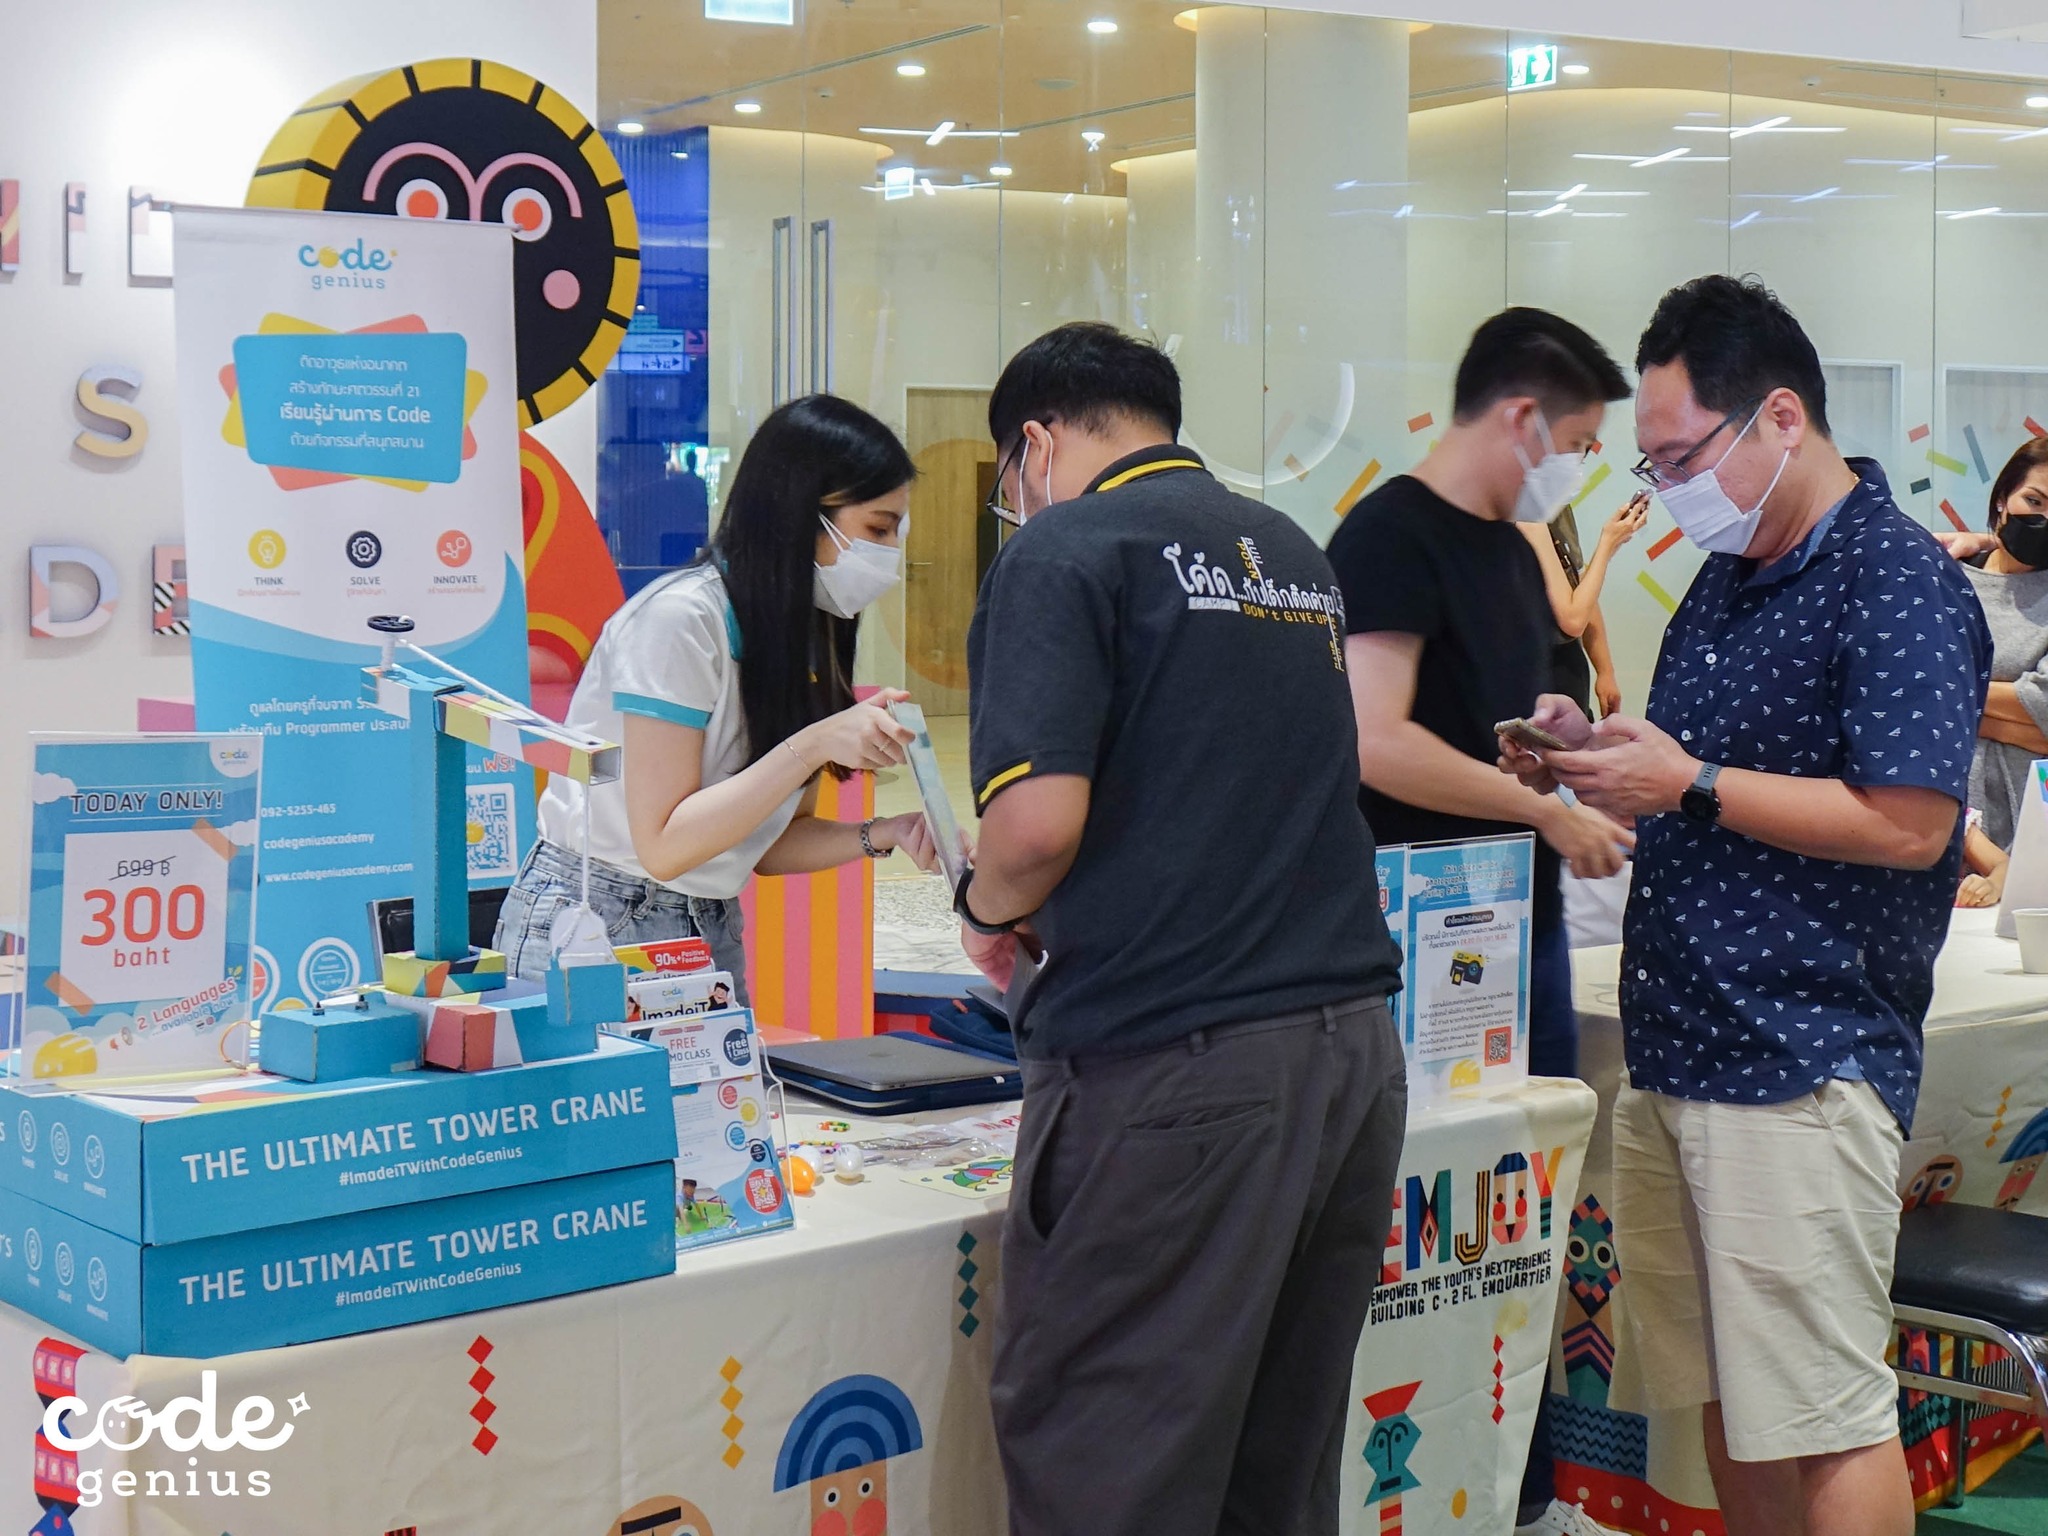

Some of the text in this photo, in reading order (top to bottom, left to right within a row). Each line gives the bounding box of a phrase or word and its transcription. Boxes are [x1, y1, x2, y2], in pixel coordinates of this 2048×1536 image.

[298, 238, 395, 271] code
[311, 272, 386, 290] genius
[407, 386, 420, 397] 21
[280, 401, 431, 427] เรียนรู้ผ่านการ Code
[1236, 542, 1259, 579] POSN
[254, 577, 284, 586] THINK
[350, 576, 381, 586] SOLVE
[433, 574, 478, 585] INNOVATE
[1284, 611, 1315, 624] GIVE
[1316, 614, 1328, 625] UP
[286, 720, 366, 736] Programmer
[70, 790, 223, 814] TODAY ONLY!
[261, 803, 337, 818] 092-5255-465
[263, 832, 375, 850] codegeniusacademy
[117, 859, 154, 877] 699
[265, 862, 414, 882] www.codegeniusacademy.com
[80, 884, 206, 946] 300
[114, 947, 171, 968] baht
[681, 949, 705, 957] Positive
[681, 955, 710, 964] Feedback
[137, 977, 236, 1030] 2 Languages
[670, 1036, 697, 1049] FREE
[725, 1038, 748, 1050] Free
[669, 1049, 711, 1061] MO CLASS
[180, 1147, 250, 1183] THE
[263, 1122, 415, 1171] ULTIMATE
[427, 1104, 539, 1145] TOWER
[551, 1087, 646, 1126] CRANE
[339, 1146, 522, 1186] #ImadeiTWithCodeGenius
[179, 1268, 246, 1305] THE
[262, 1240, 415, 1292] ULTIMATE
[428, 1219, 540, 1263] TOWER
[552, 1199, 647, 1241] CRANE
[335, 1263, 522, 1307] #ImadeiTWithCodeGenius
[1371, 1249, 1552, 1307] EMPOWER THE YOUTH'S NEXTPERIENCE
[1371, 1265, 1551, 1326] BUILDING C 2 FL. EMQUARTIER
